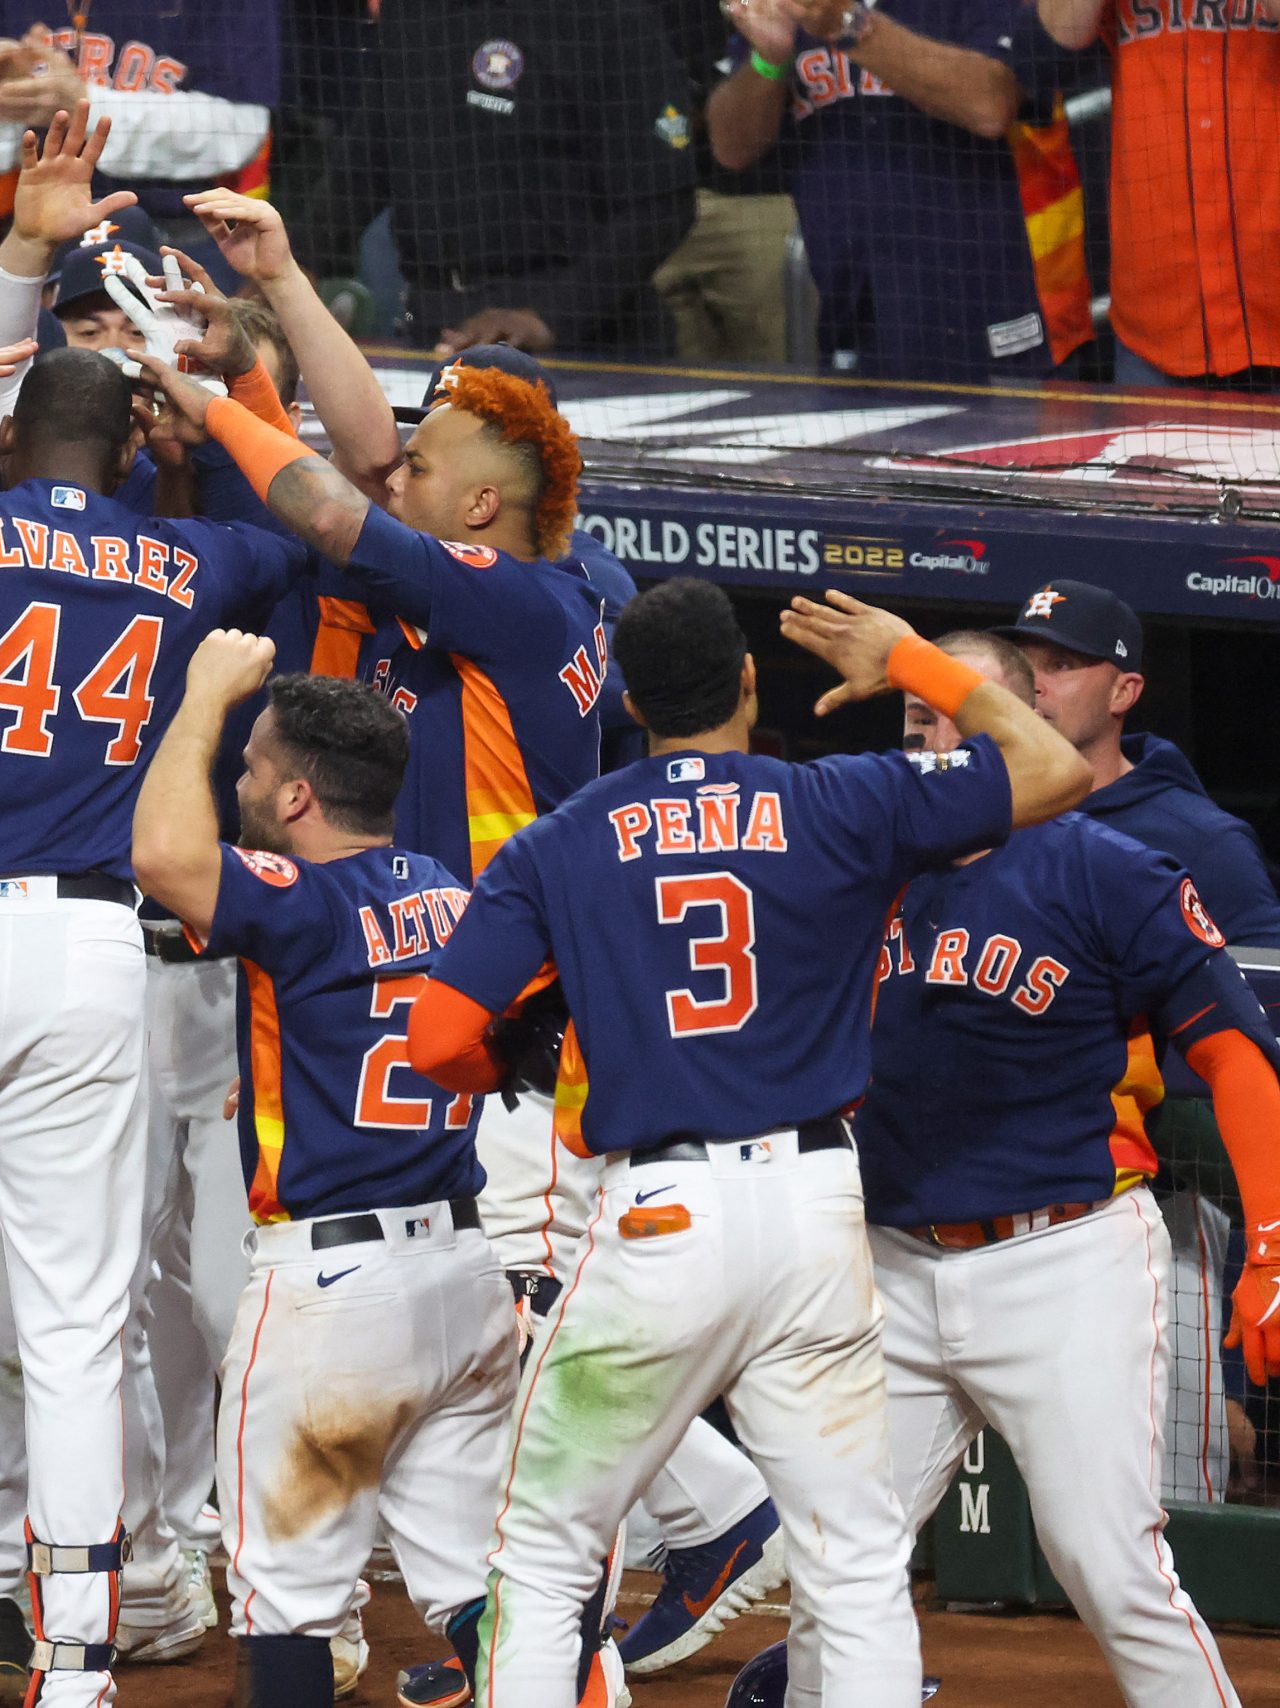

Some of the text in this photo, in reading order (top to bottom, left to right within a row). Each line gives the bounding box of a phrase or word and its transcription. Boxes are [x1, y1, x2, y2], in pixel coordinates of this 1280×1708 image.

[574, 514, 690, 564] ORLD
[696, 522, 820, 576] SERIES
[824, 543, 904, 568] 2022
[608, 782, 788, 863] PEÑA
[655, 871, 758, 1039] 3
[353, 972, 476, 1131] 2
